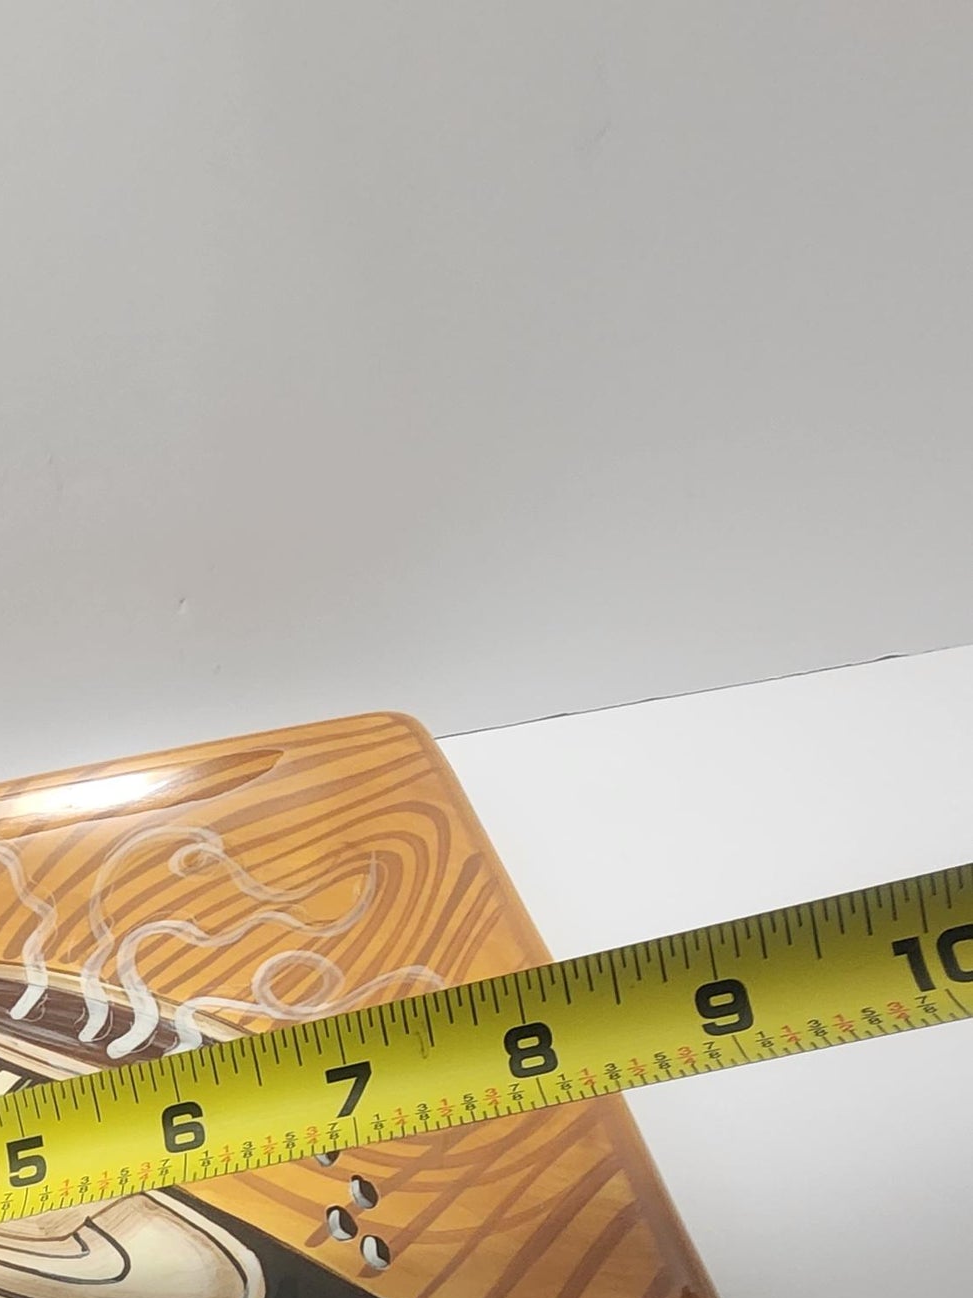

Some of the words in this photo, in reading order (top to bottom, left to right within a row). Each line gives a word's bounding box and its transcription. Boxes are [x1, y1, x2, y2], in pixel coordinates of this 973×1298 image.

[6, 1135, 47, 1188] 5
[161, 1101, 206, 1153] 6
[325, 1061, 372, 1118] 7
[504, 1022, 558, 1079] 8
[695, 978, 754, 1036] 9
[892, 922, 973, 992] 10
